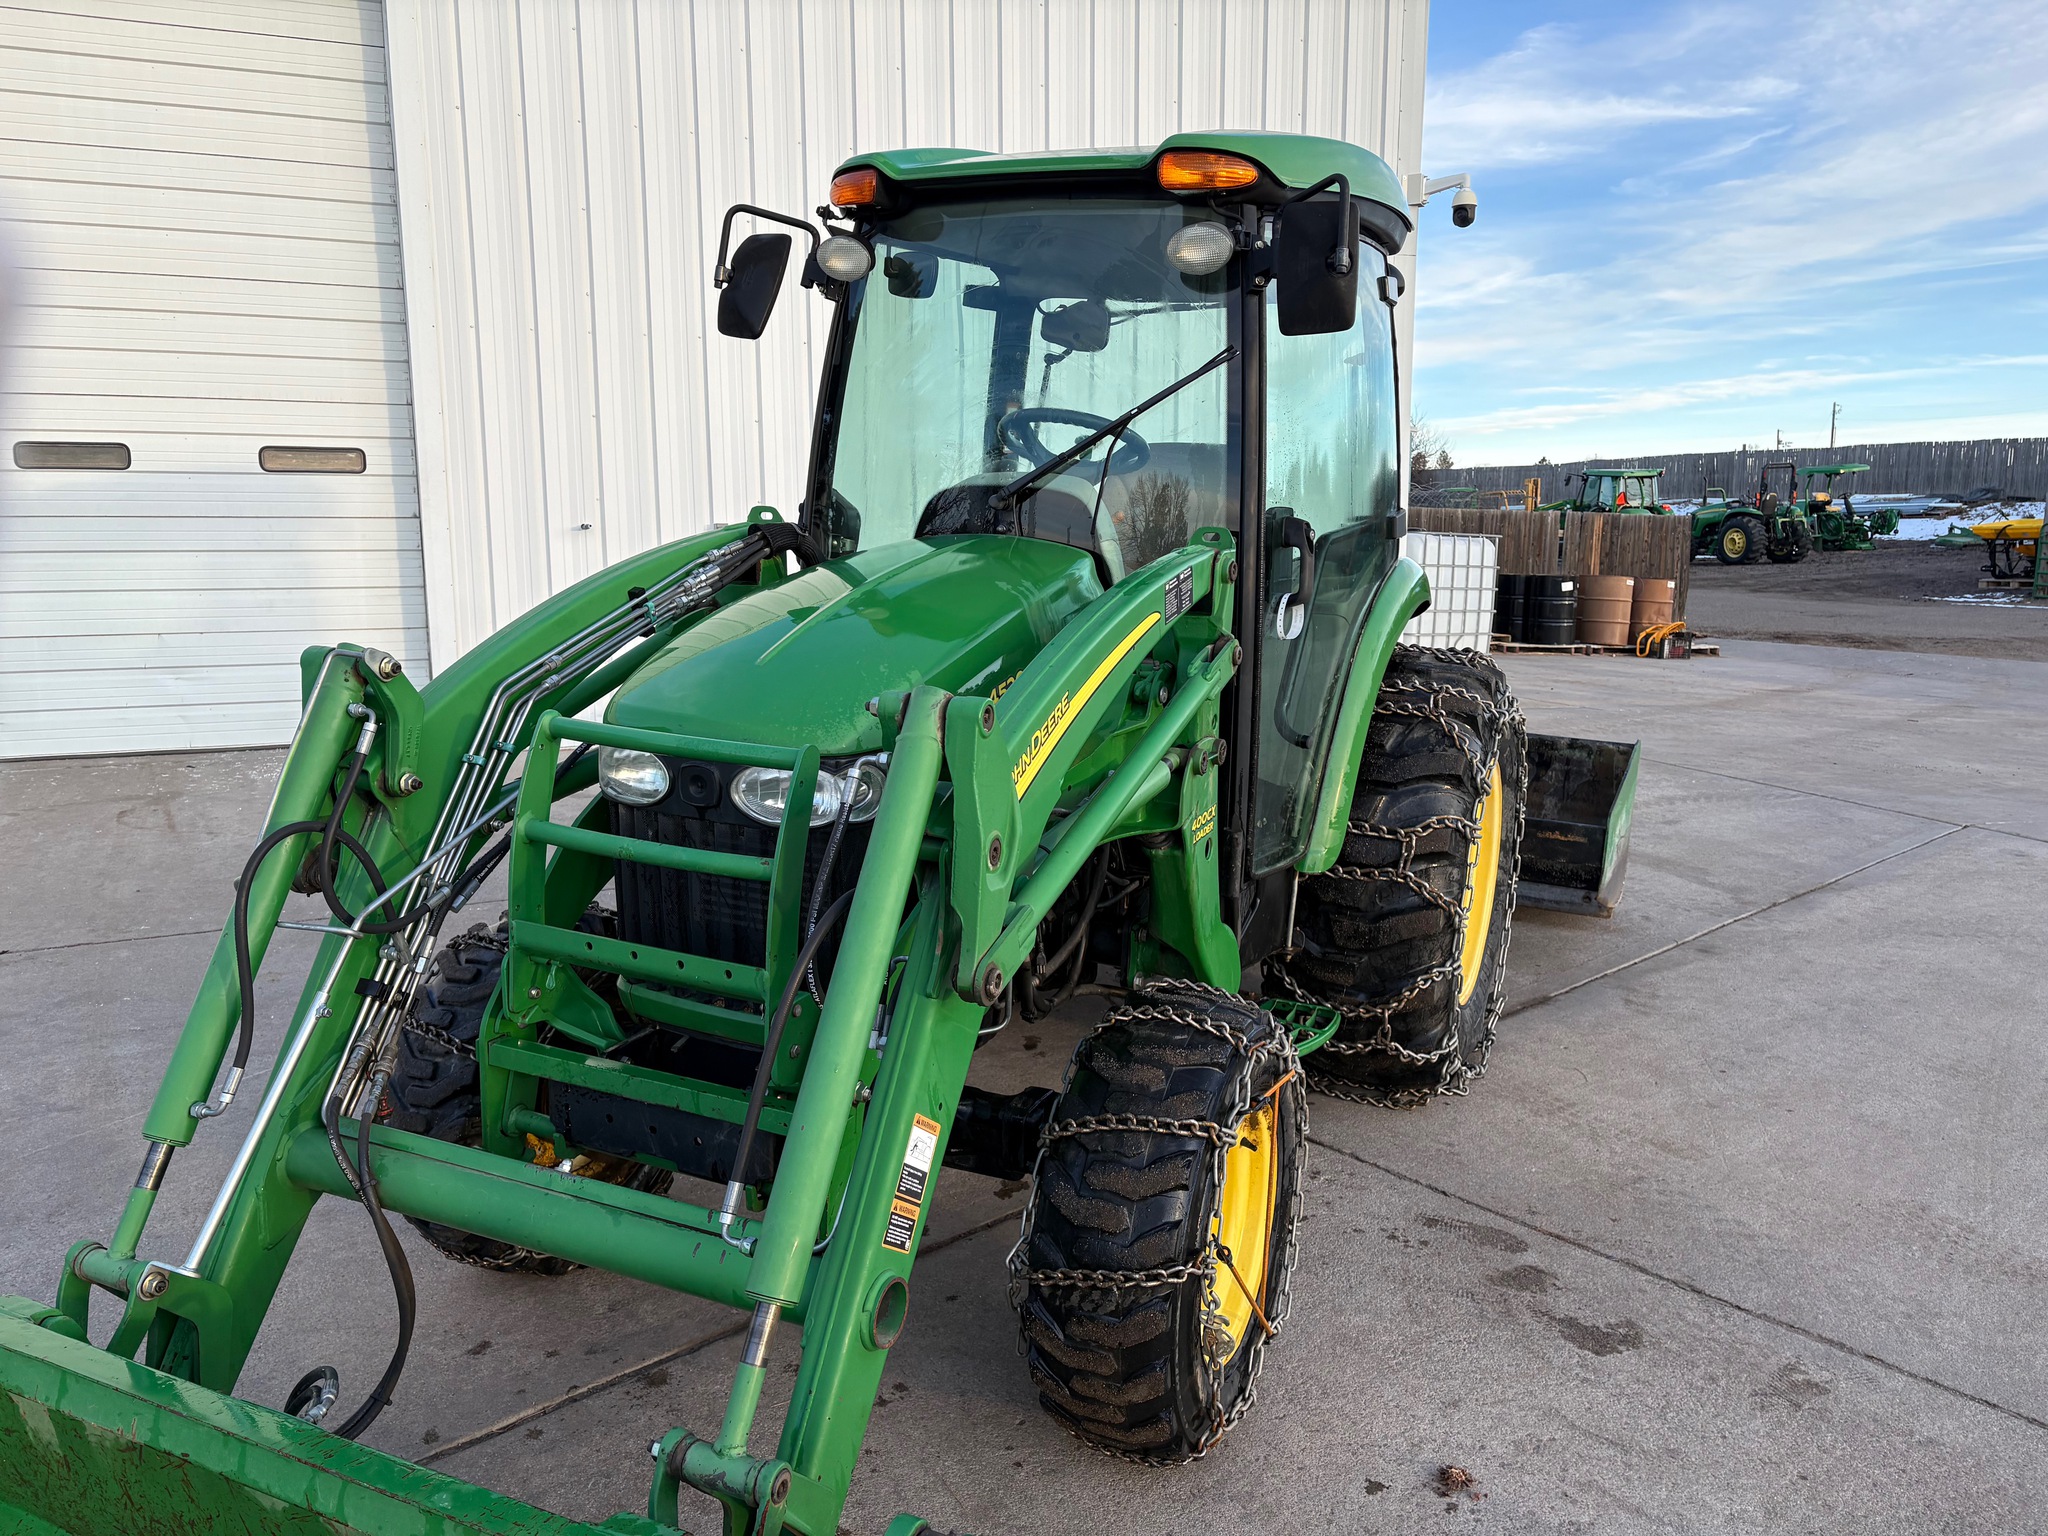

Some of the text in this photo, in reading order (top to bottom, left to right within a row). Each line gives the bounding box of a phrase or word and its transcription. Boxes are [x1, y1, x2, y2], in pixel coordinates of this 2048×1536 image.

[1011, 690, 1071, 785] HN DEERE
[1191, 804, 1217, 832] 400CX
[1193, 821, 1214, 845] LOADER
[921, 1119, 938, 1133] WARNING
[898, 1204, 917, 1217] WARNING
